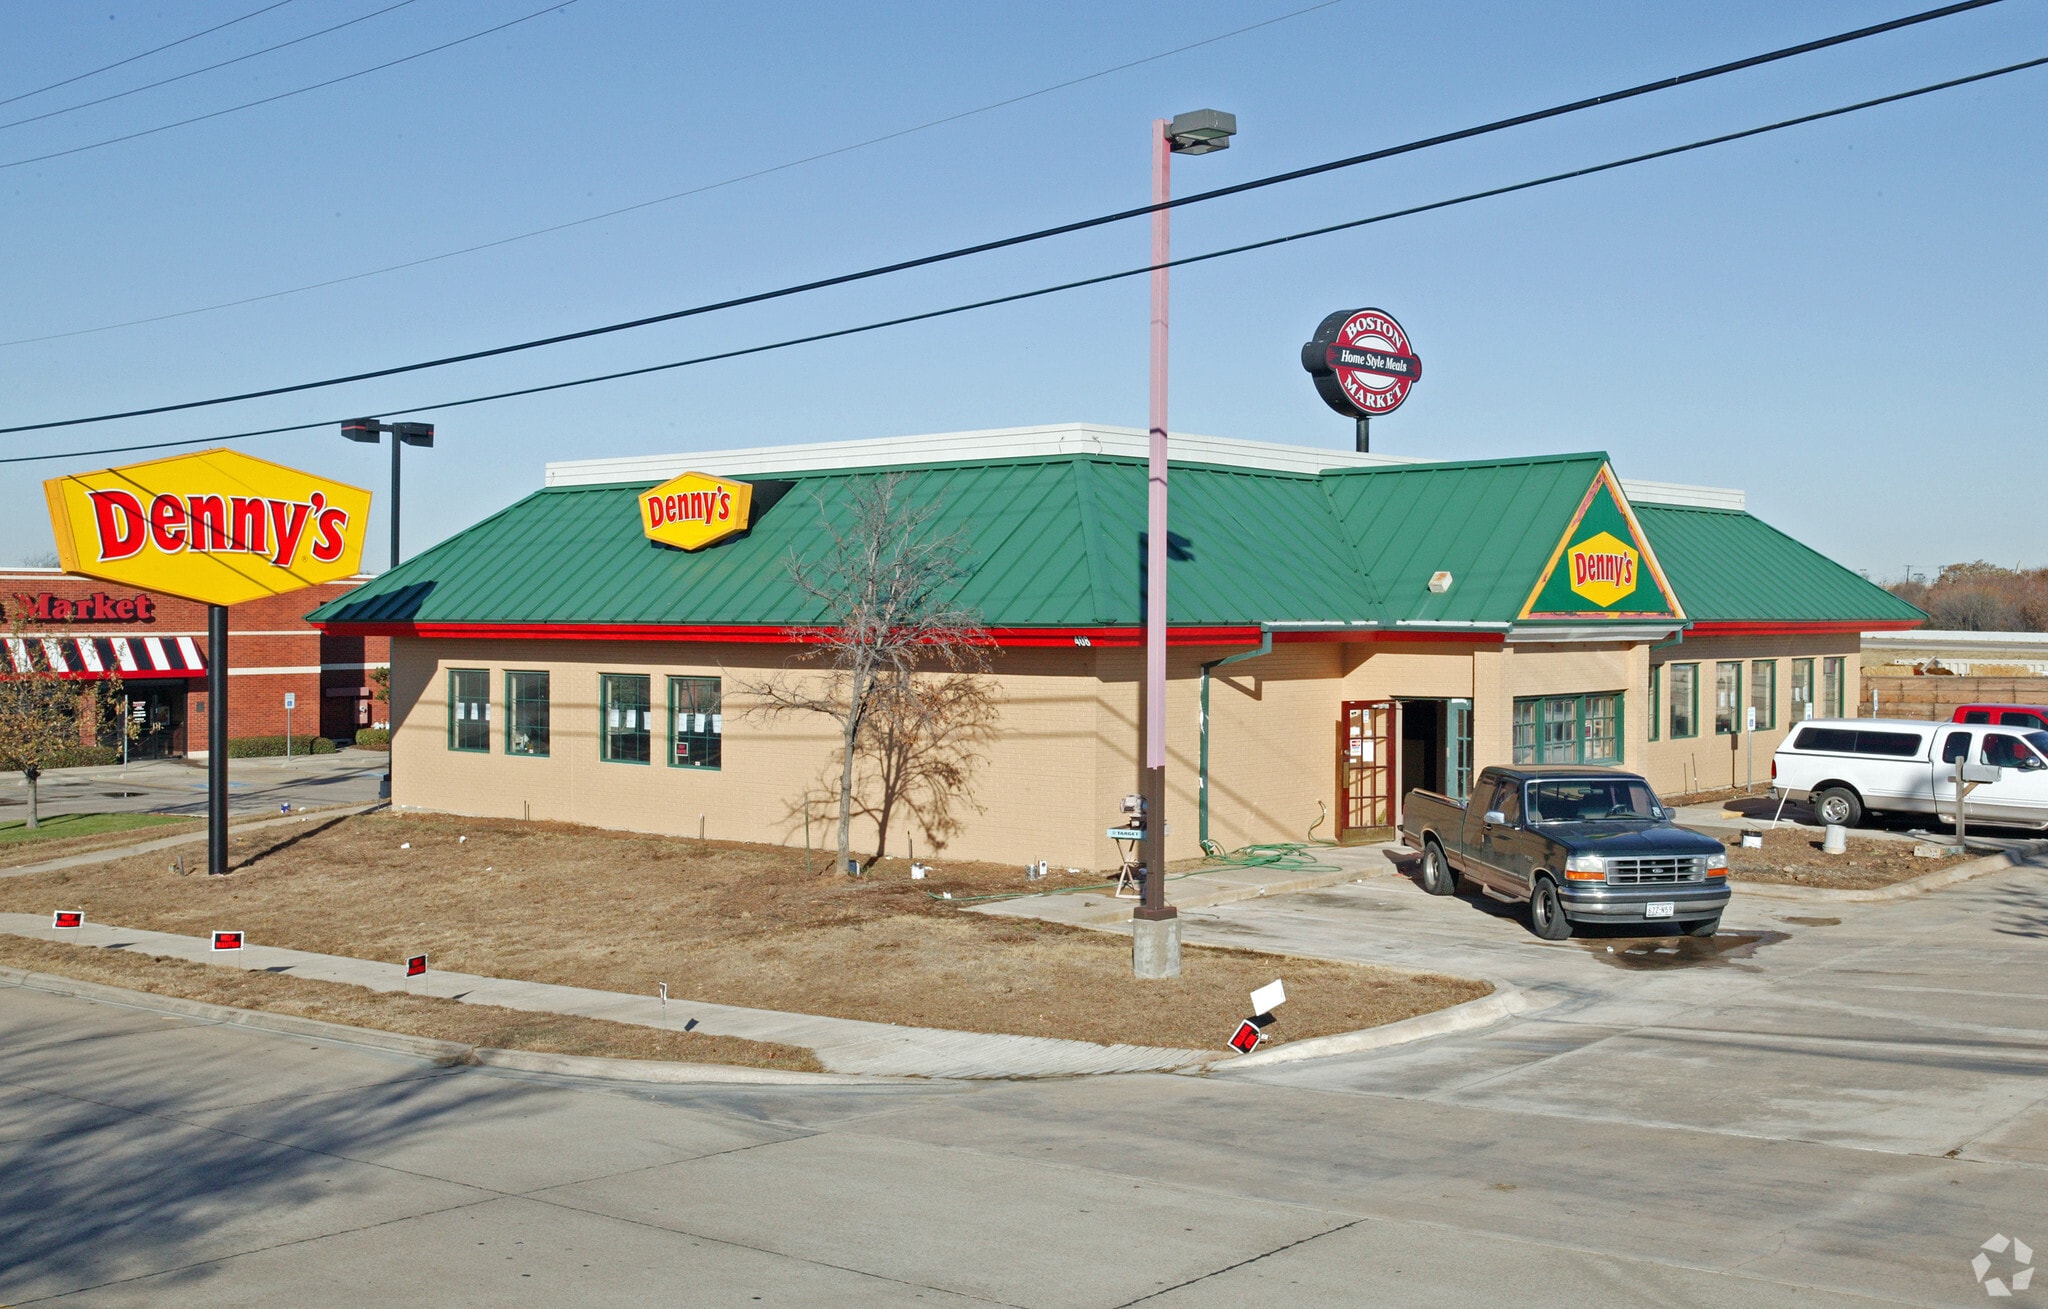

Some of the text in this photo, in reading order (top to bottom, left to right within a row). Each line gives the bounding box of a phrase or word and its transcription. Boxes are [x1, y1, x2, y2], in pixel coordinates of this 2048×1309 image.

[1345, 317, 1404, 349] BOSTON
[1340, 349, 1408, 372] Home Style Meals
[1344, 374, 1402, 408] MARKET
[647, 485, 731, 531] Denny's
[86, 489, 349, 568] Denny's
[1575, 551, 1633, 589] Denny's
[14, 592, 152, 620] Market
